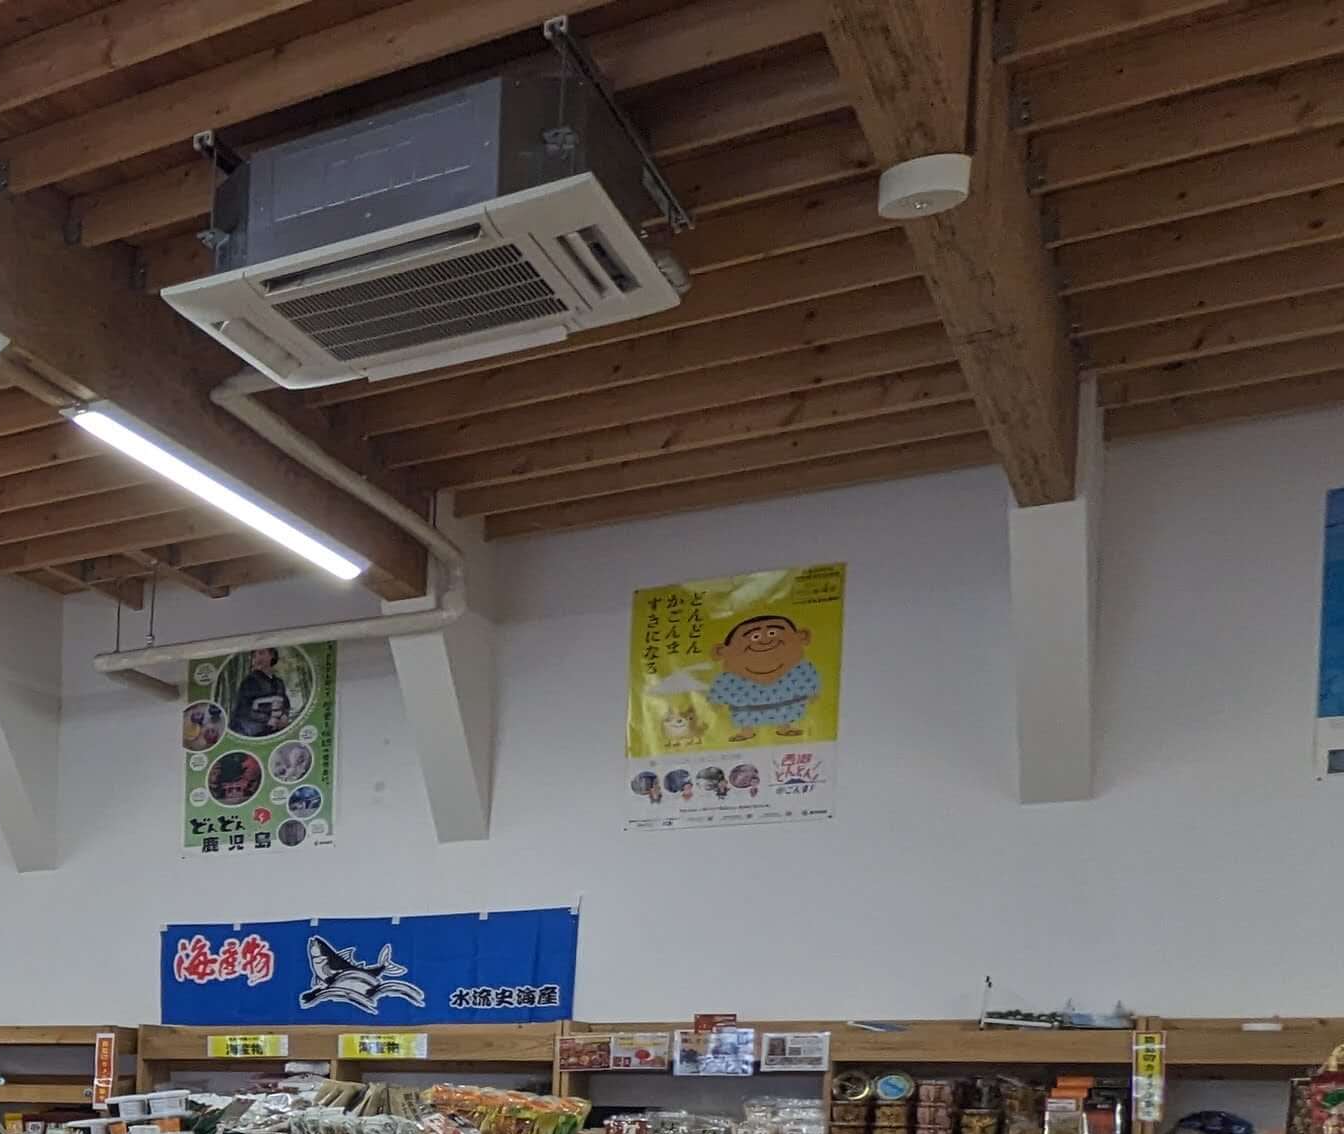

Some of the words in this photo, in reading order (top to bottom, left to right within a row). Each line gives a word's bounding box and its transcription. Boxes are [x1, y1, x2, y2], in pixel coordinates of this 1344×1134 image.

[190, 814, 246, 835] どんどん
[201, 831, 272, 854] 鹿児島
[174, 933, 275, 985] 海産物
